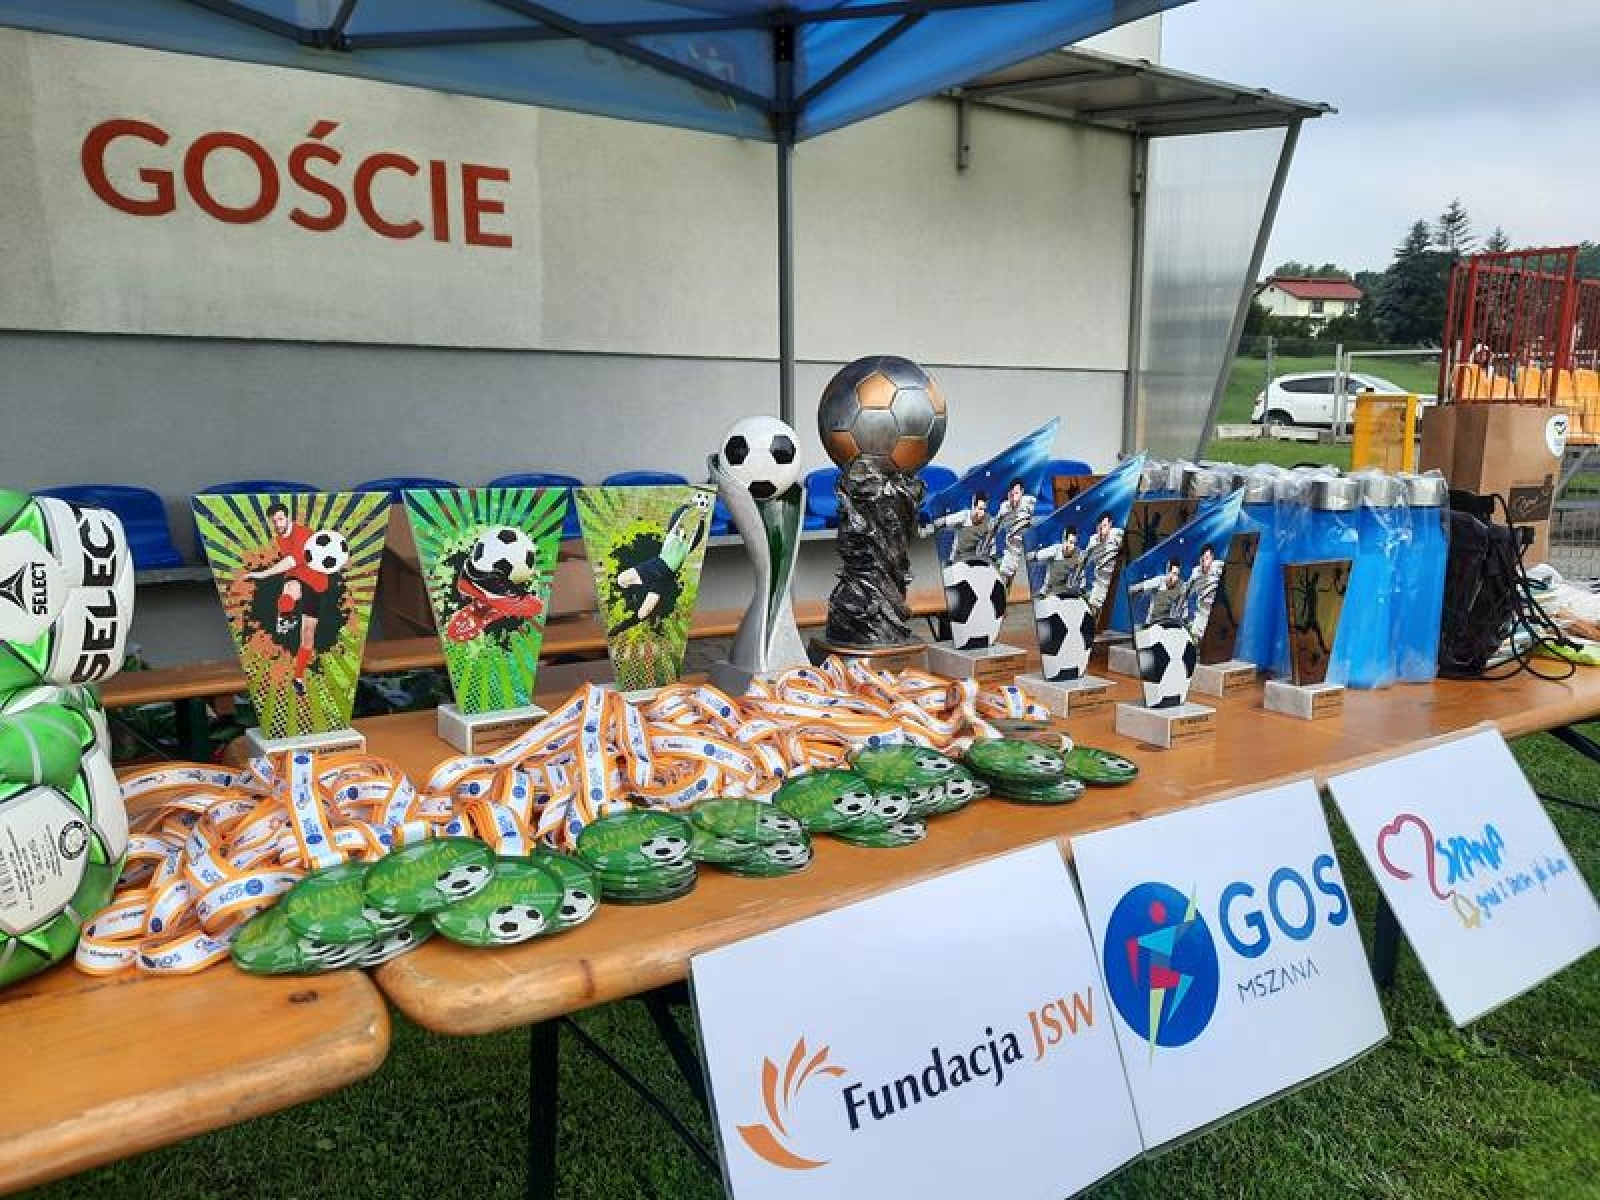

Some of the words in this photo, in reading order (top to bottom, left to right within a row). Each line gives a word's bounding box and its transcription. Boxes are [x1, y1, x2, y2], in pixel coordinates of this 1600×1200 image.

[81, 119, 513, 248] GOŚCIE
[32, 561, 48, 615] SELECT
[71, 504, 118, 684] SELEC
[1219, 854, 1348, 958] GOS
[1236, 957, 1320, 1003] MSZANA
[842, 1026, 1023, 1131] Fundacja
[1027, 986, 1097, 1060] JSW
